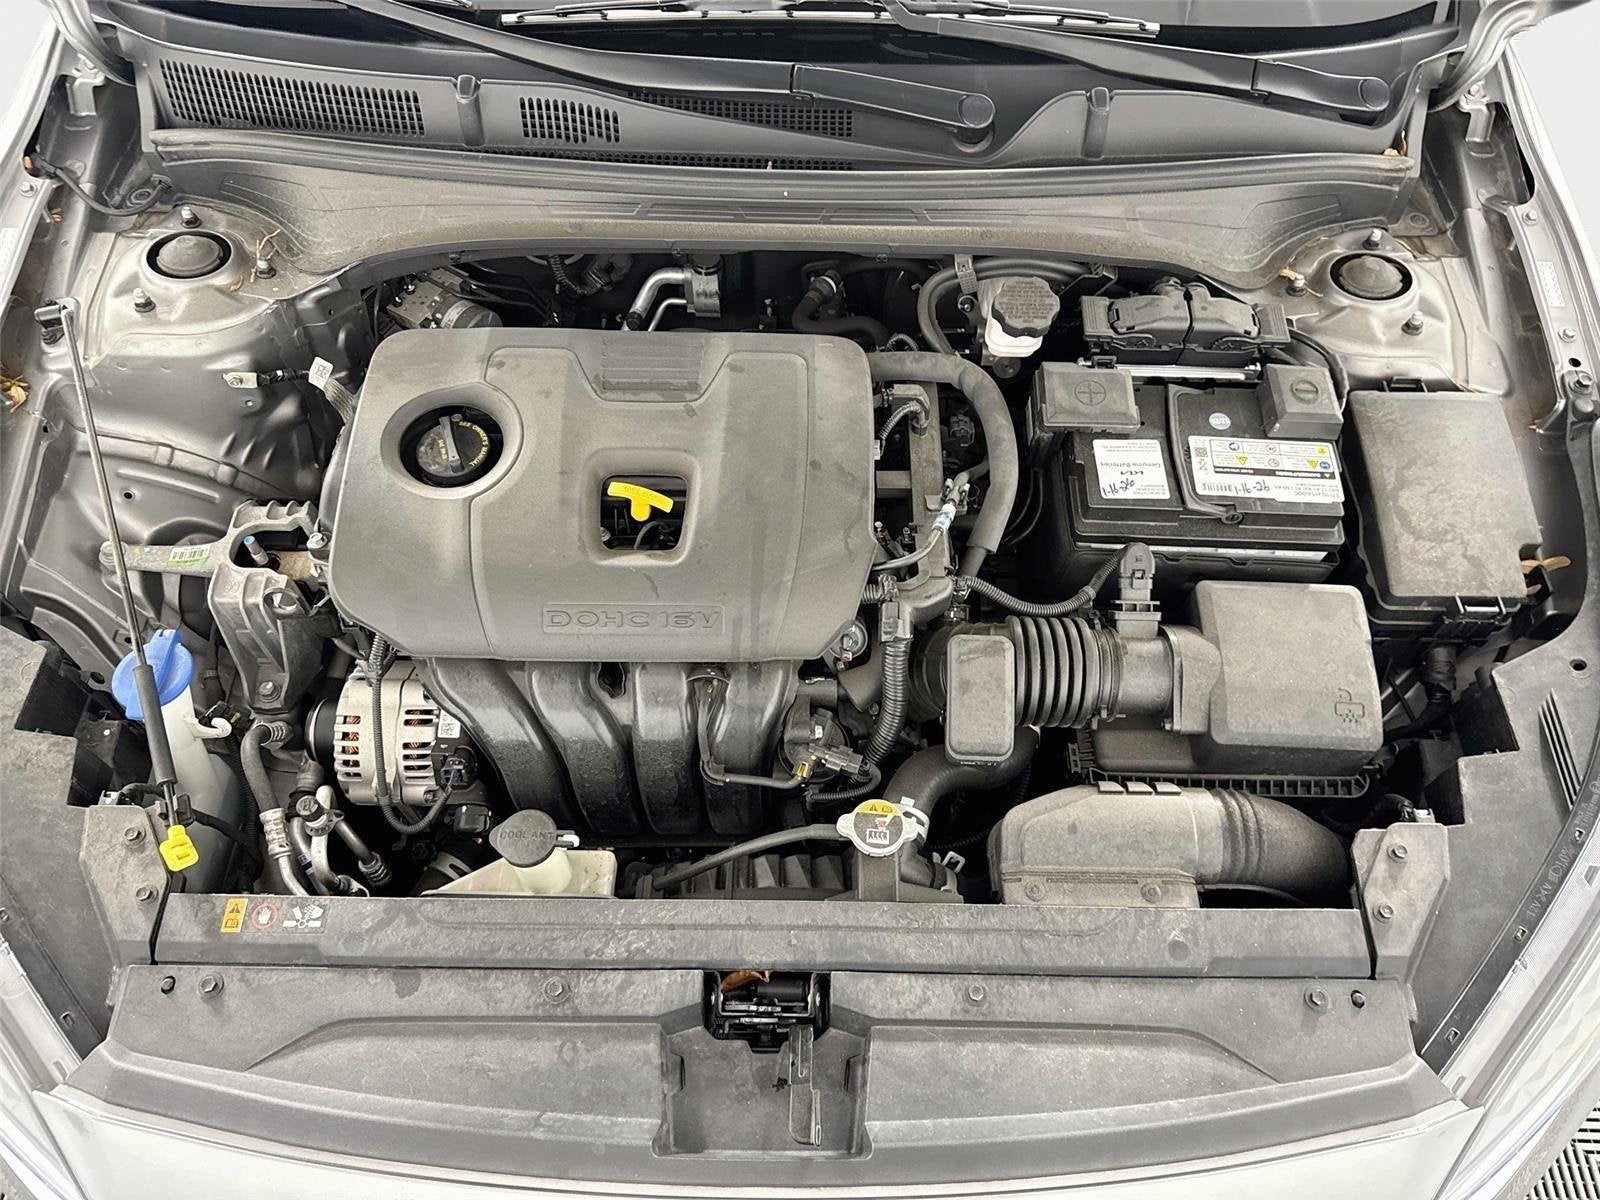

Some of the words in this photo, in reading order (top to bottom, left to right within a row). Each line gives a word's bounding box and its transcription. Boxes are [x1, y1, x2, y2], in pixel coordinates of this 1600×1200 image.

[545, 610, 650, 629] DOHC
[659, 610, 721, 629] 16V
[499, 829, 555, 842] COOLANT
